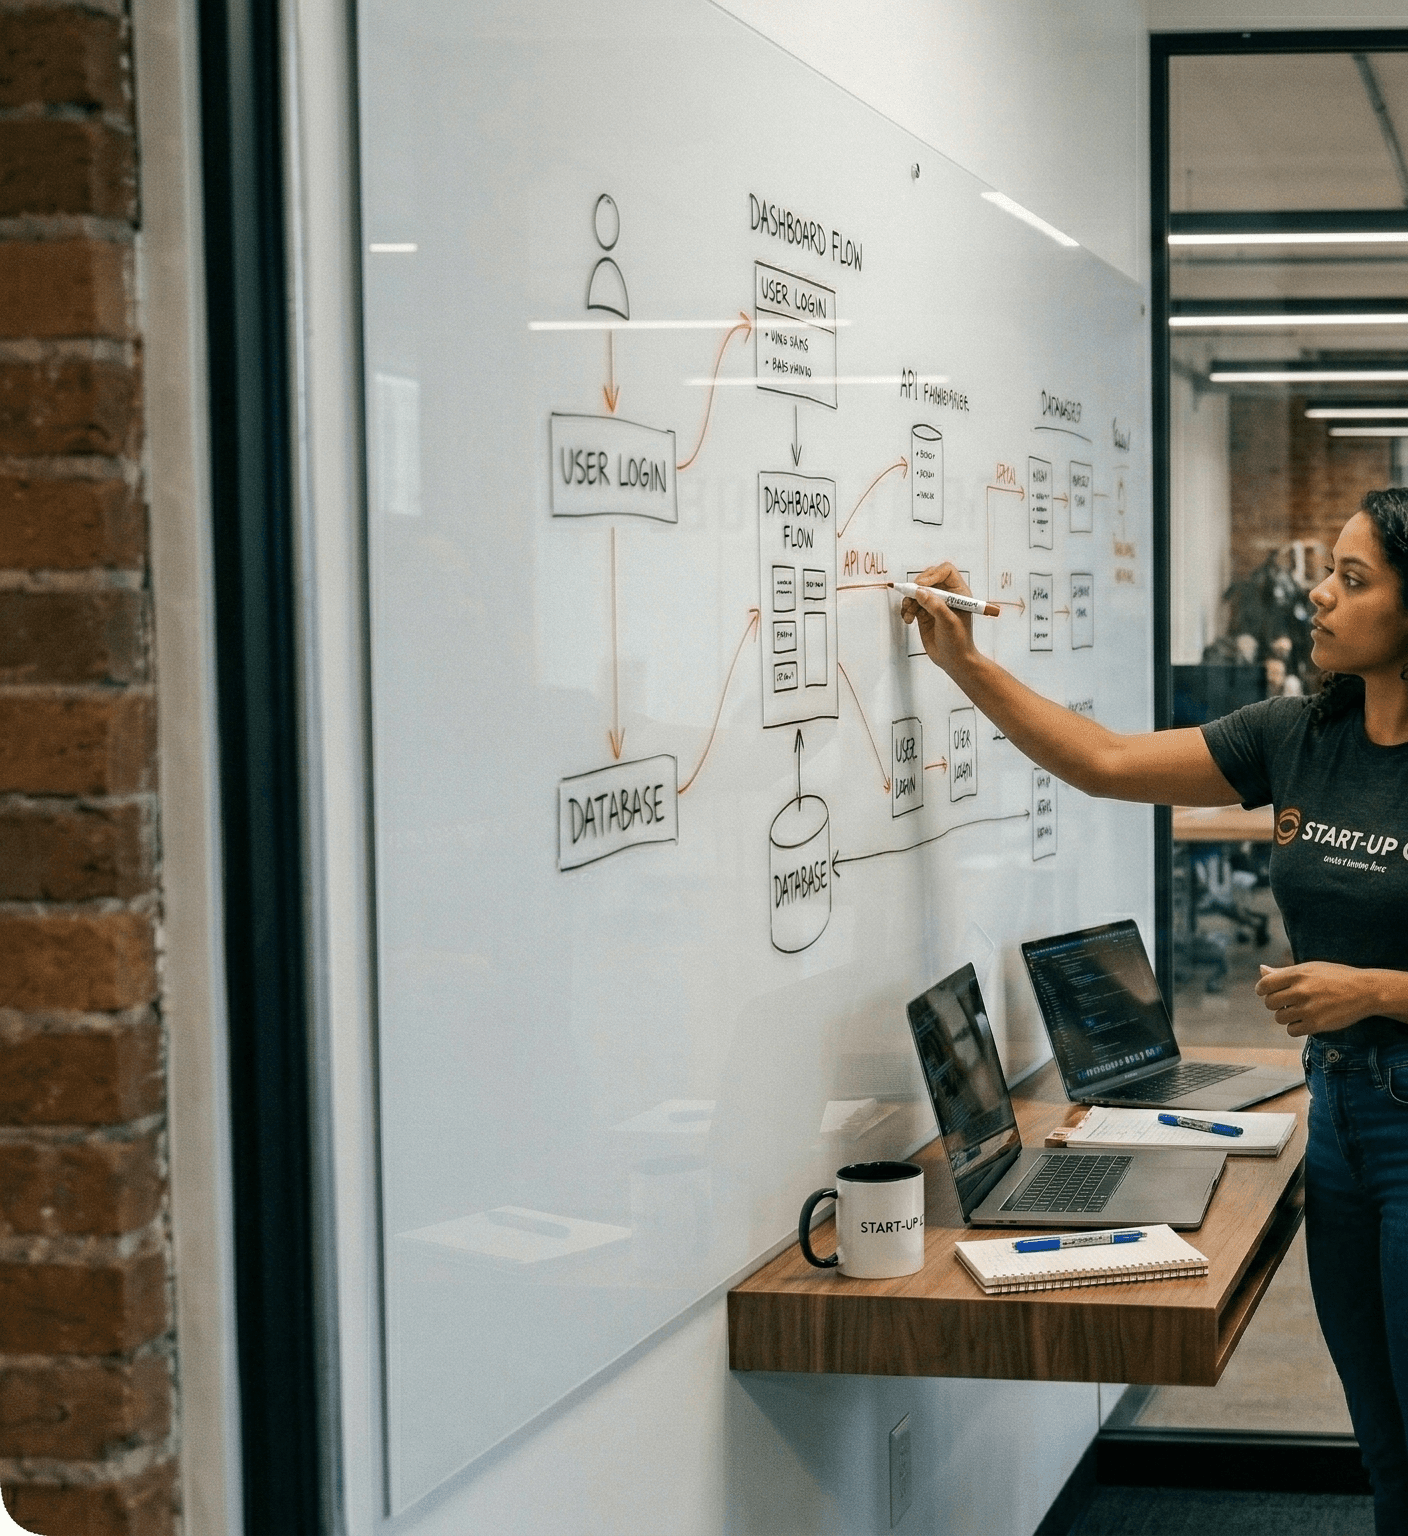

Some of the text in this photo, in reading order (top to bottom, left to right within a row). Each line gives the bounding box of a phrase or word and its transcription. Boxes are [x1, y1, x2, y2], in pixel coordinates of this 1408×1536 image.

[749, 193, 863, 272] DASHBOARD FLOW
[762, 276, 827, 319] USER LOGIN
[900, 367, 918, 400] API
[561, 447, 666, 493] USER LOGIN
[764, 486, 831, 518] DASHBOARD
[783, 525, 814, 549] FLOW
[843, 549, 888, 577] API CALL
[568, 784, 665, 844] DATABASE
[1301, 821, 1399, 856] START-UP
[774, 860, 828, 909] DATABASE
[860, 1216, 919, 1234] START-UP
